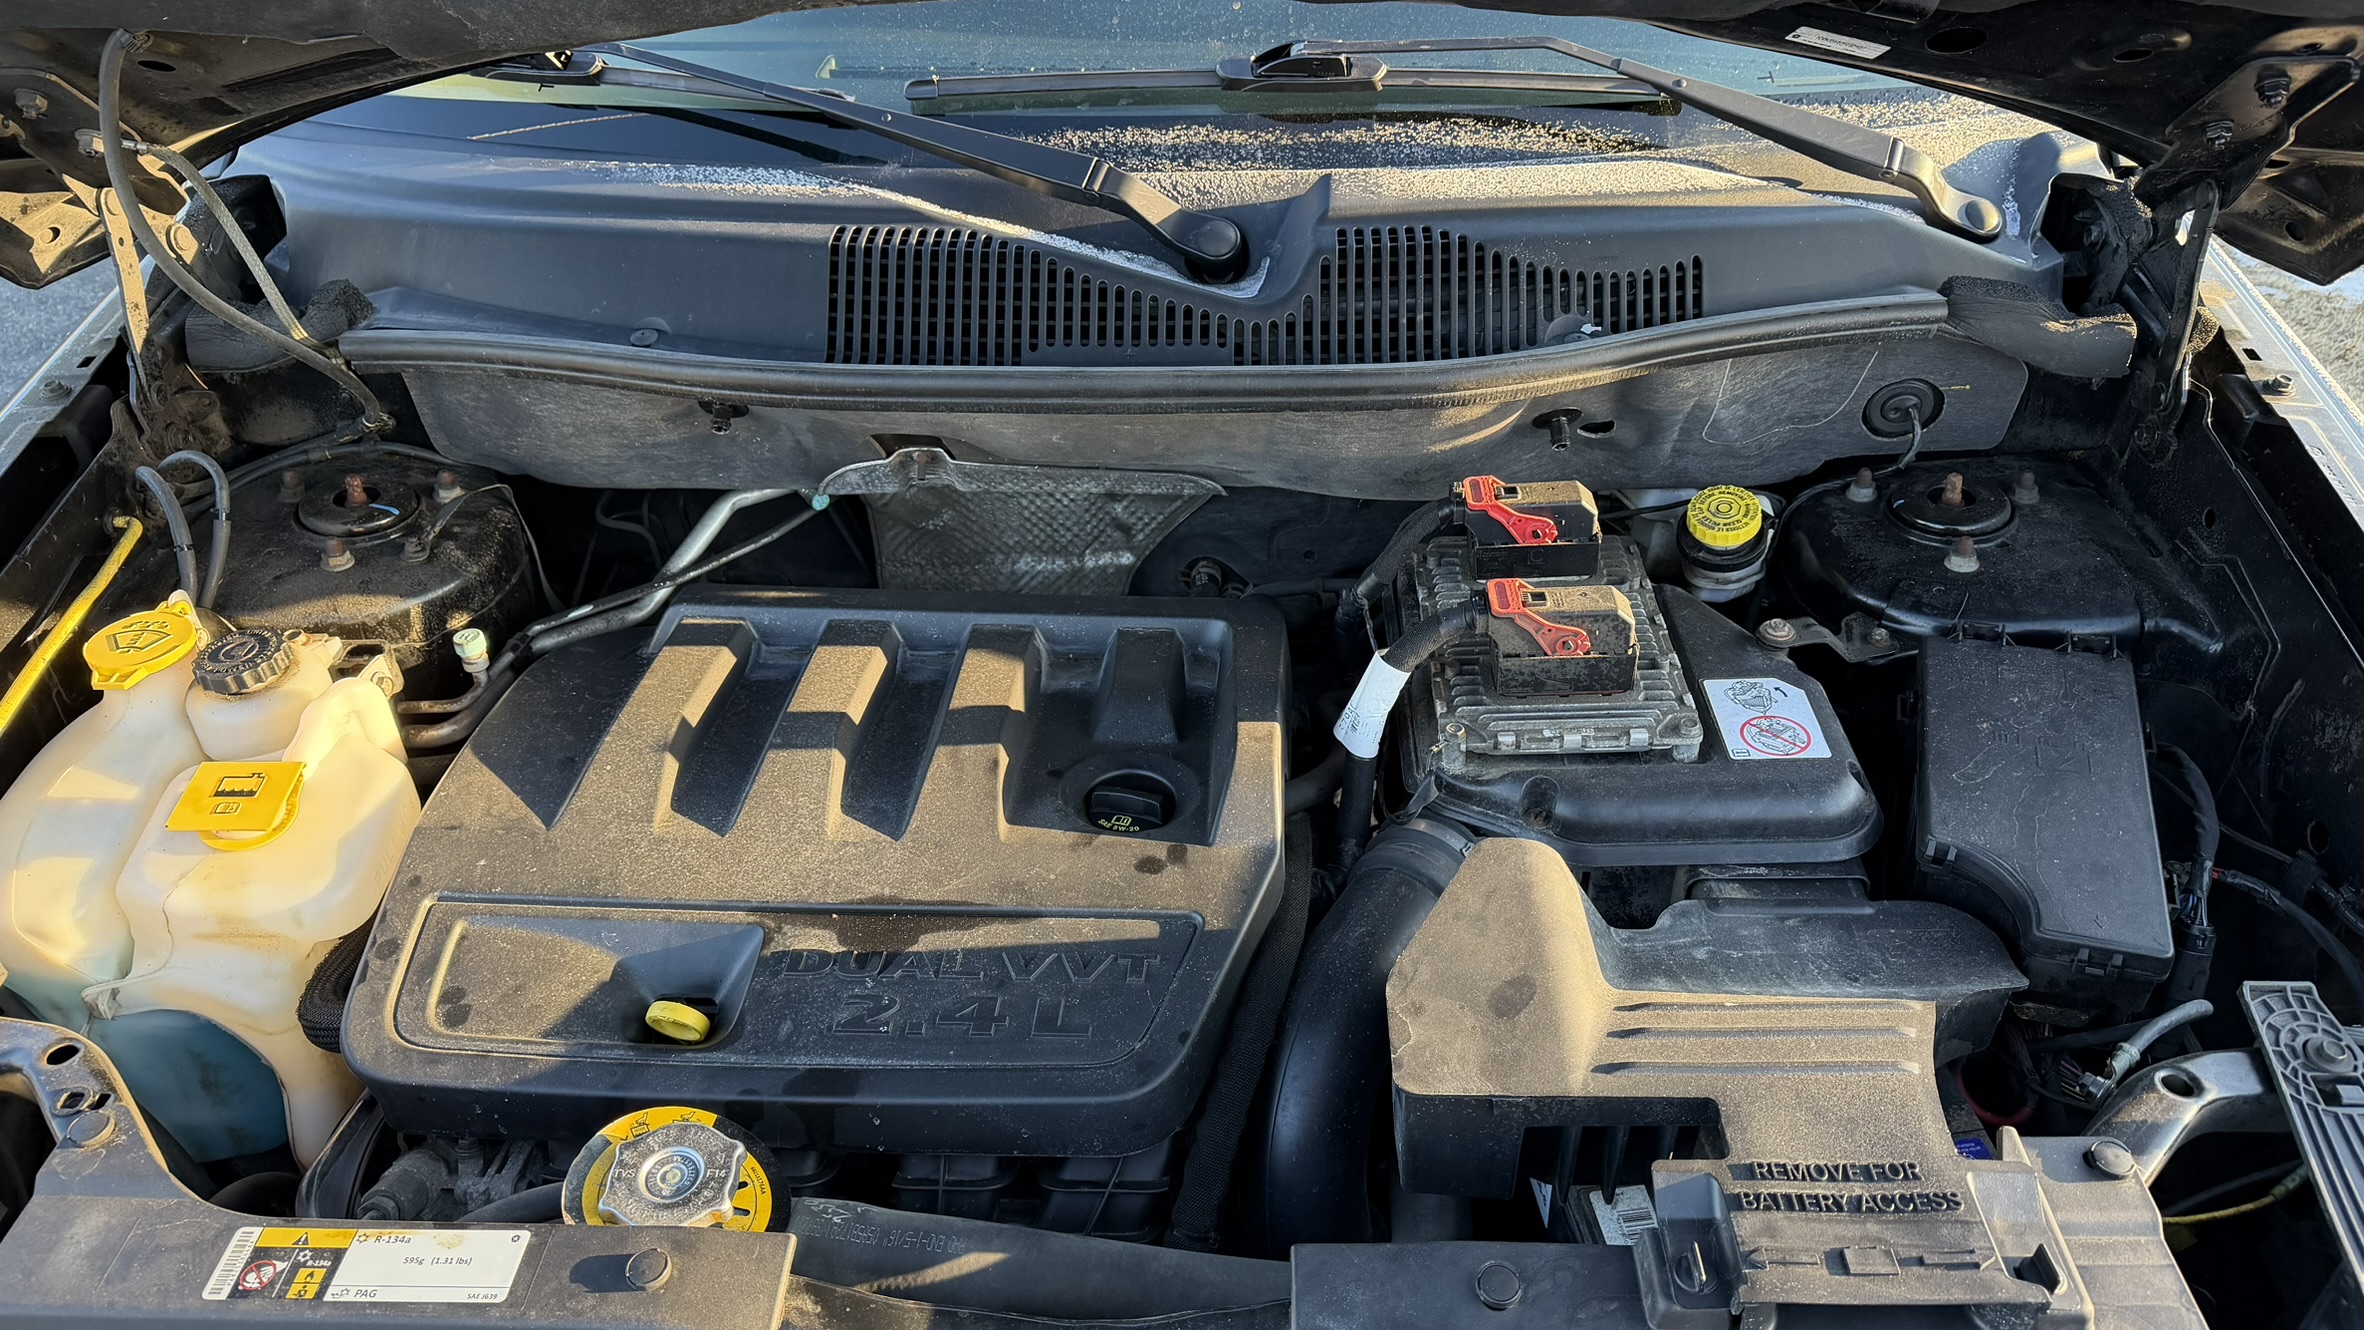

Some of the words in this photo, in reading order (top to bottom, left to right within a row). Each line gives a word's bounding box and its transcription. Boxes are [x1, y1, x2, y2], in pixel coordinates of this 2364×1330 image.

[1098, 818, 1113, 829] SAE
[782, 949, 985, 981] DUAL
[1001, 951, 1161, 983] VVT
[613, 1168, 636, 1178] TVS
[706, 1168, 728, 1178] F14
[1753, 1161, 1864, 1182] REMOVE
[1869, 1161, 1923, 1181] FOR
[1739, 1191, 1849, 1212] BATTERY
[1859, 1191, 1965, 1212] ACCESS
[373, 1235, 412, 1244] R-134a
[402, 1256, 426, 1265] 595g
[431, 1256, 454, 1265] (1.31
[455, 1256, 473, 1265] lbs)
[353, 1289, 378, 1298] PAG
